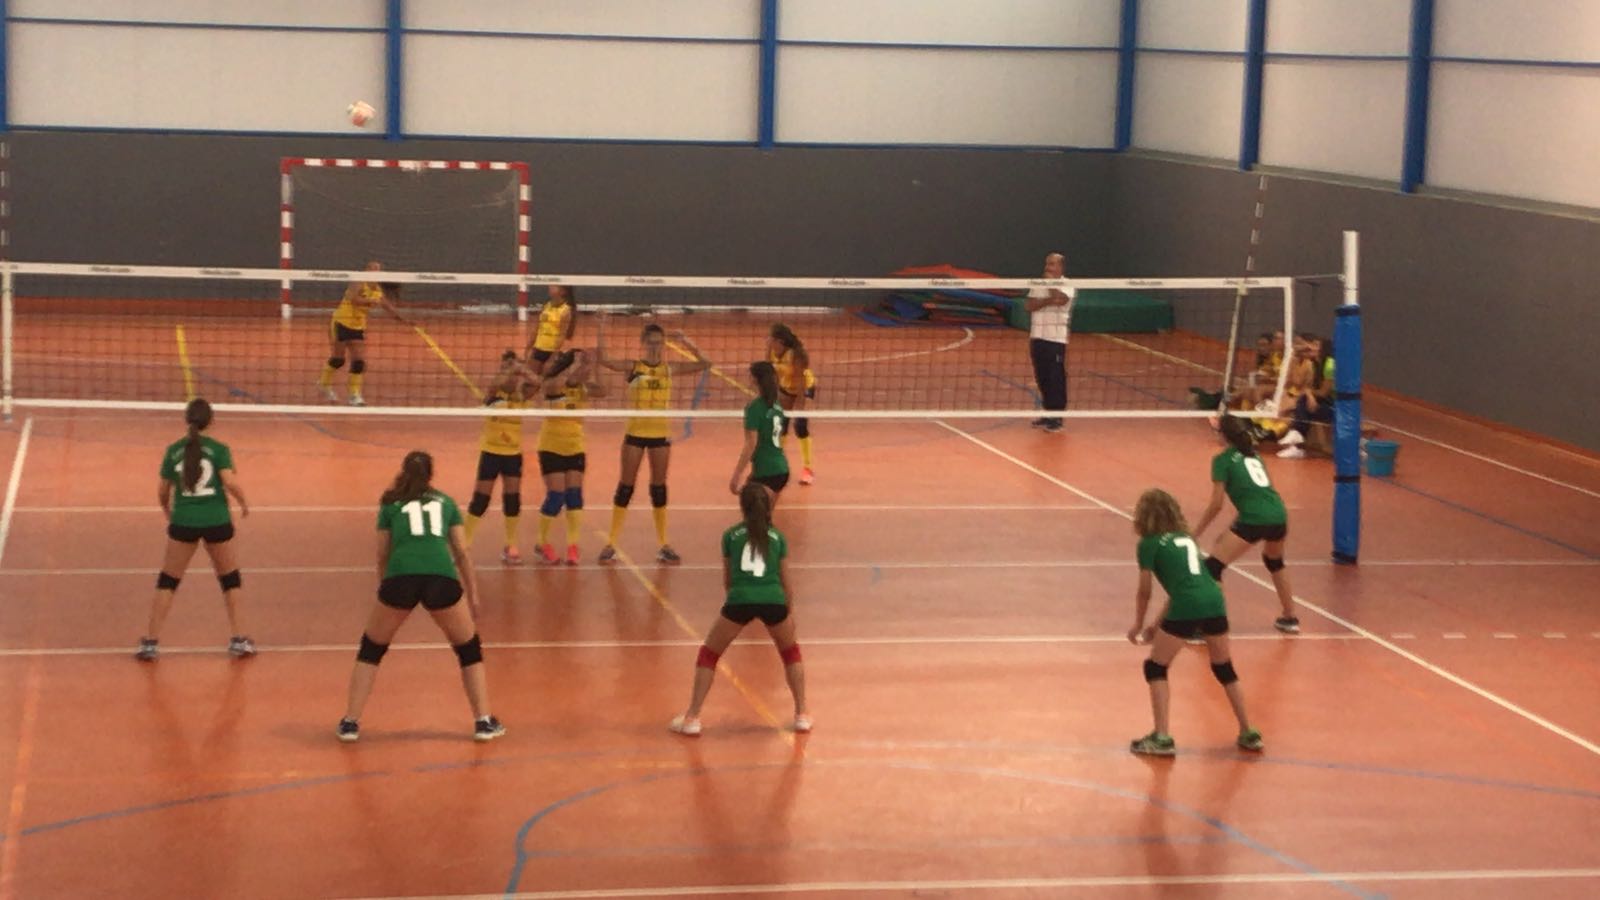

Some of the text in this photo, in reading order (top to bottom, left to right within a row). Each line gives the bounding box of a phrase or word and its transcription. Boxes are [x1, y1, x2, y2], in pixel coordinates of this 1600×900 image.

[174, 458, 217, 497] 2
[1243, 457, 1270, 487] 6
[401, 500, 443, 536] 11
[741, 541, 766, 577] 4
[1173, 537, 1201, 575] 7
